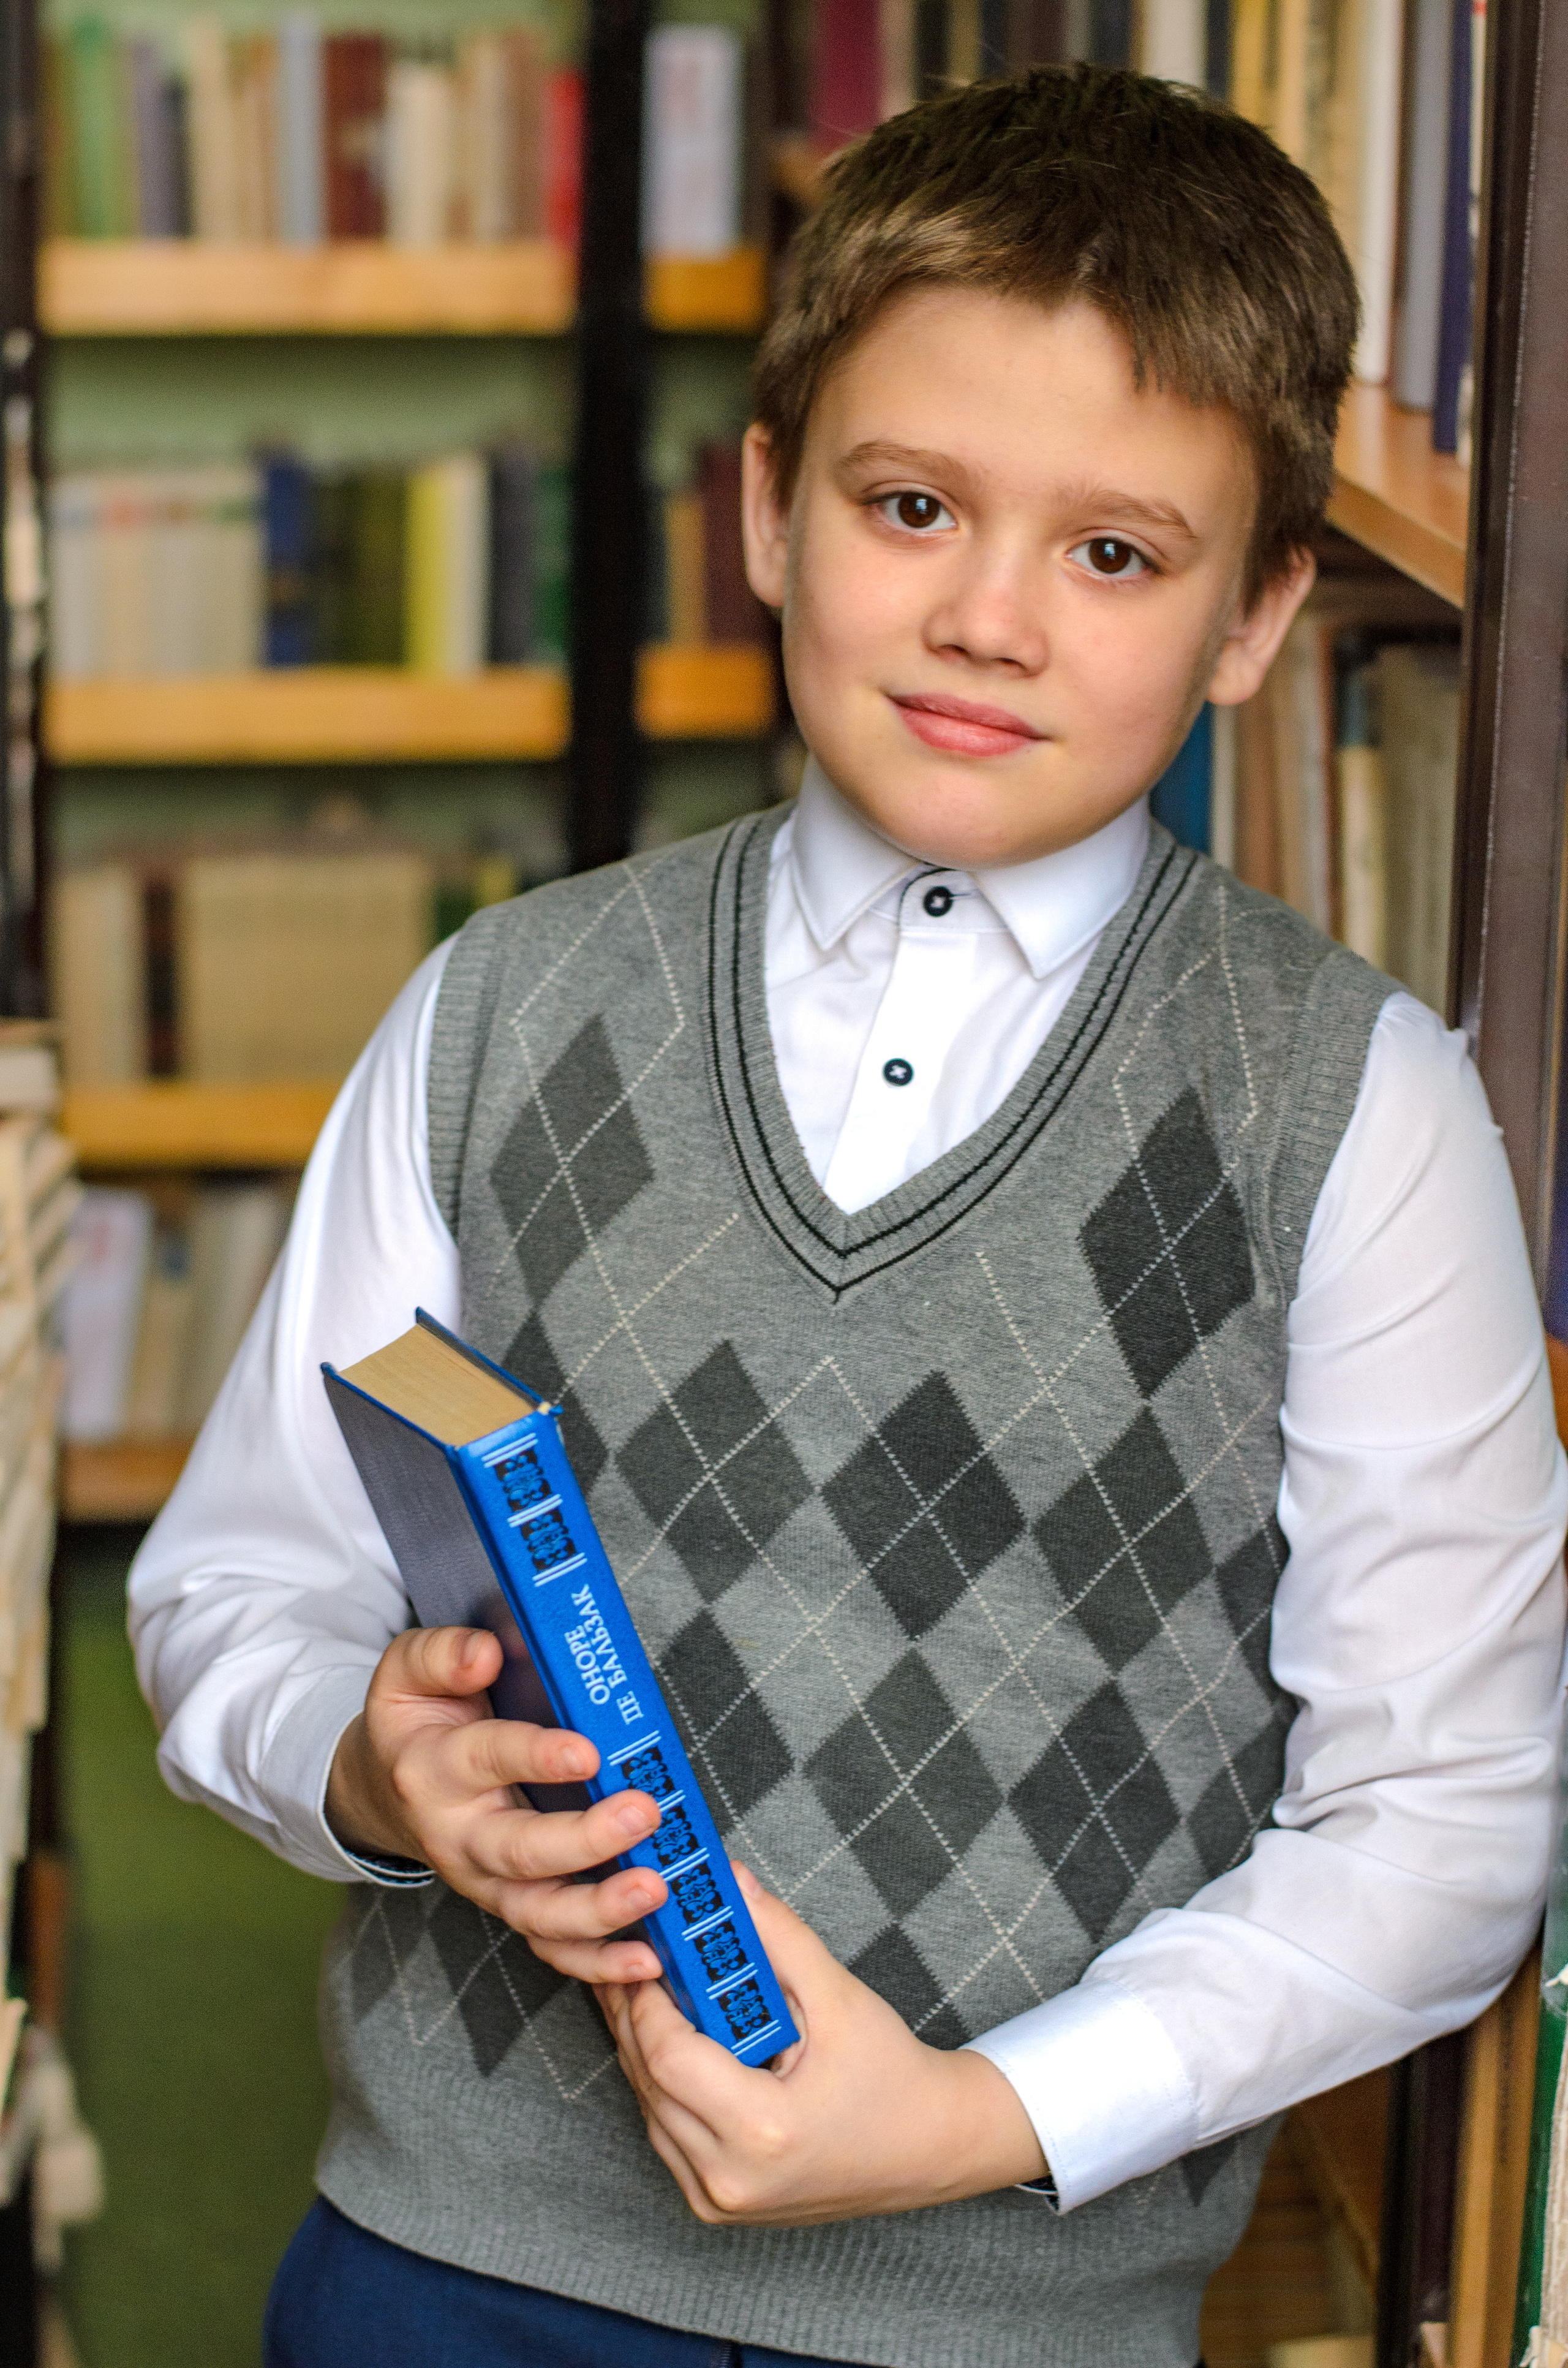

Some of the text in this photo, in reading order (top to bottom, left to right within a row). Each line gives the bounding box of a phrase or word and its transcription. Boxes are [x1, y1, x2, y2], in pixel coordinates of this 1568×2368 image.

[564, 1625, 610, 1704] ОНОРЕ
[571, 1584, 644, 1725] ДЕ БАЛЬЗАК
